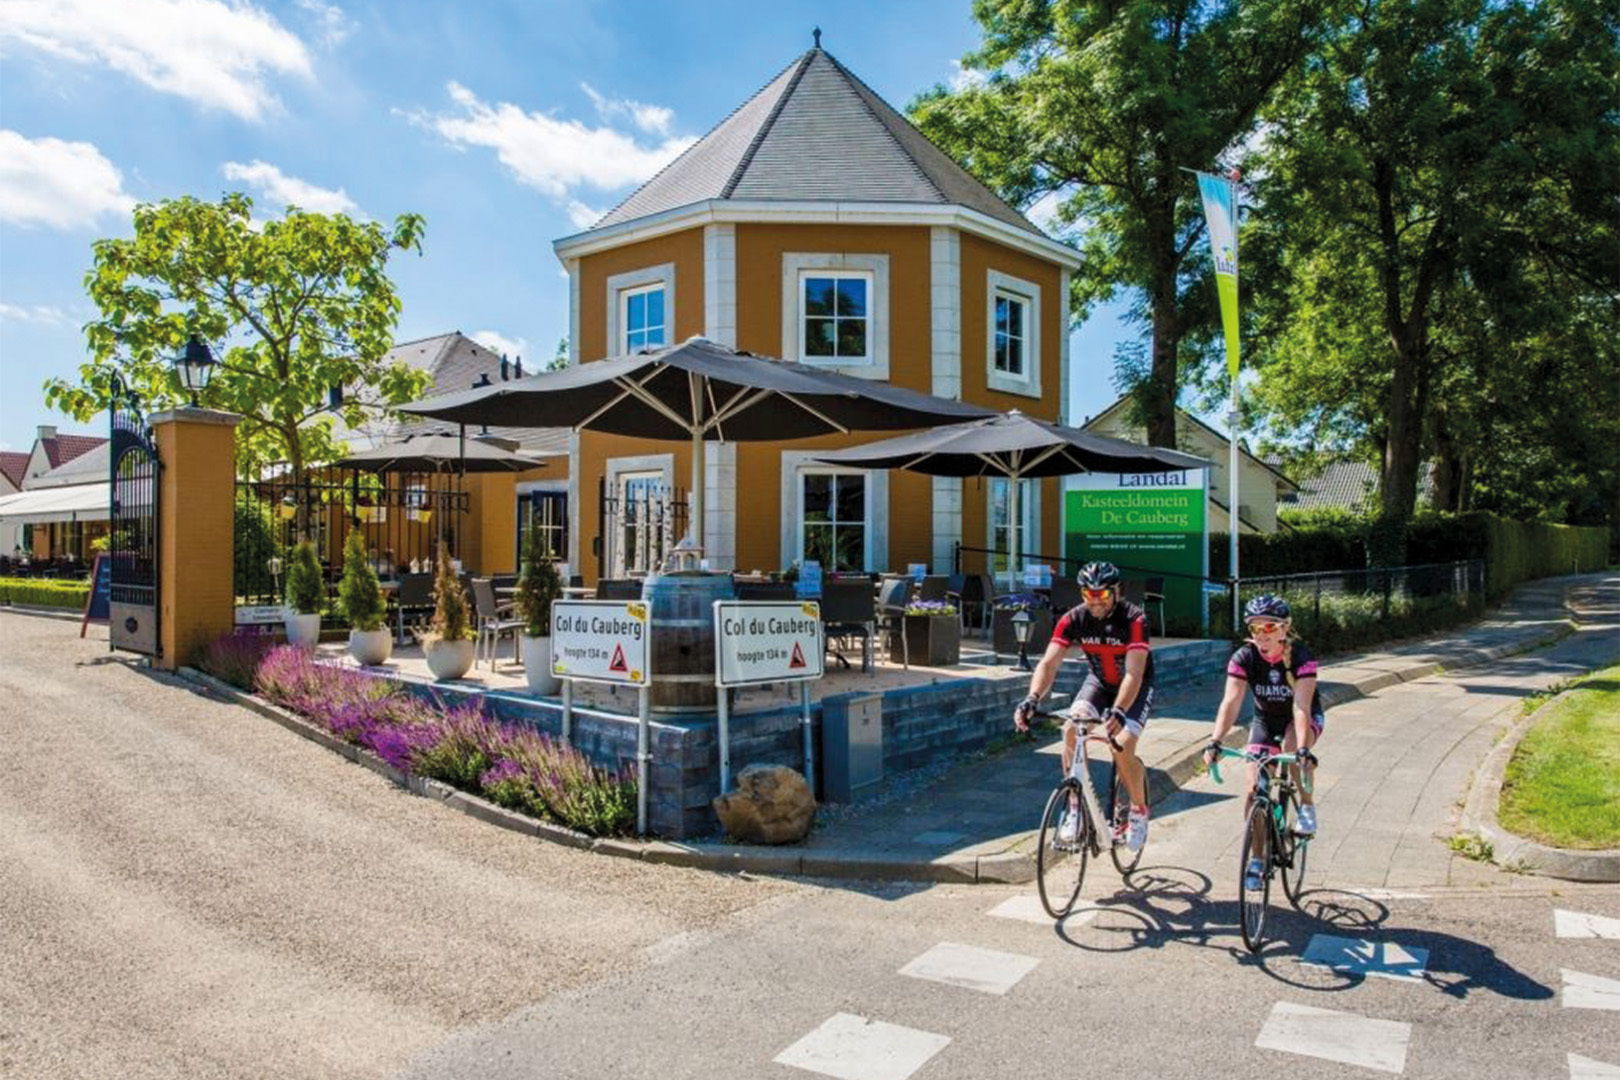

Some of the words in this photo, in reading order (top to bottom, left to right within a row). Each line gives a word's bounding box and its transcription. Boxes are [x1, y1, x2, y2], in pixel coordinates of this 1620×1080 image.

[1119, 471, 1187, 487] Landal
[1082, 493, 1188, 508] Kasteeldomein
[1102, 511, 1123, 524] De
[1126, 510, 1189, 526] Cauberg
[556, 616, 572, 632] Col
[575, 617, 588, 633] du
[591, 617, 642, 640] Cauberg
[724, 618, 745, 635] Col
[749, 618, 765, 635] du
[768, 618, 816, 637] Cauberg
[564, 647, 587, 660] hoogte
[587, 648, 600, 658] 134
[601, 651, 609, 659] m
[736, 651, 765, 663] hoogte
[766, 648, 779, 659] 134
[1255, 684, 1293, 697] BIANCH
